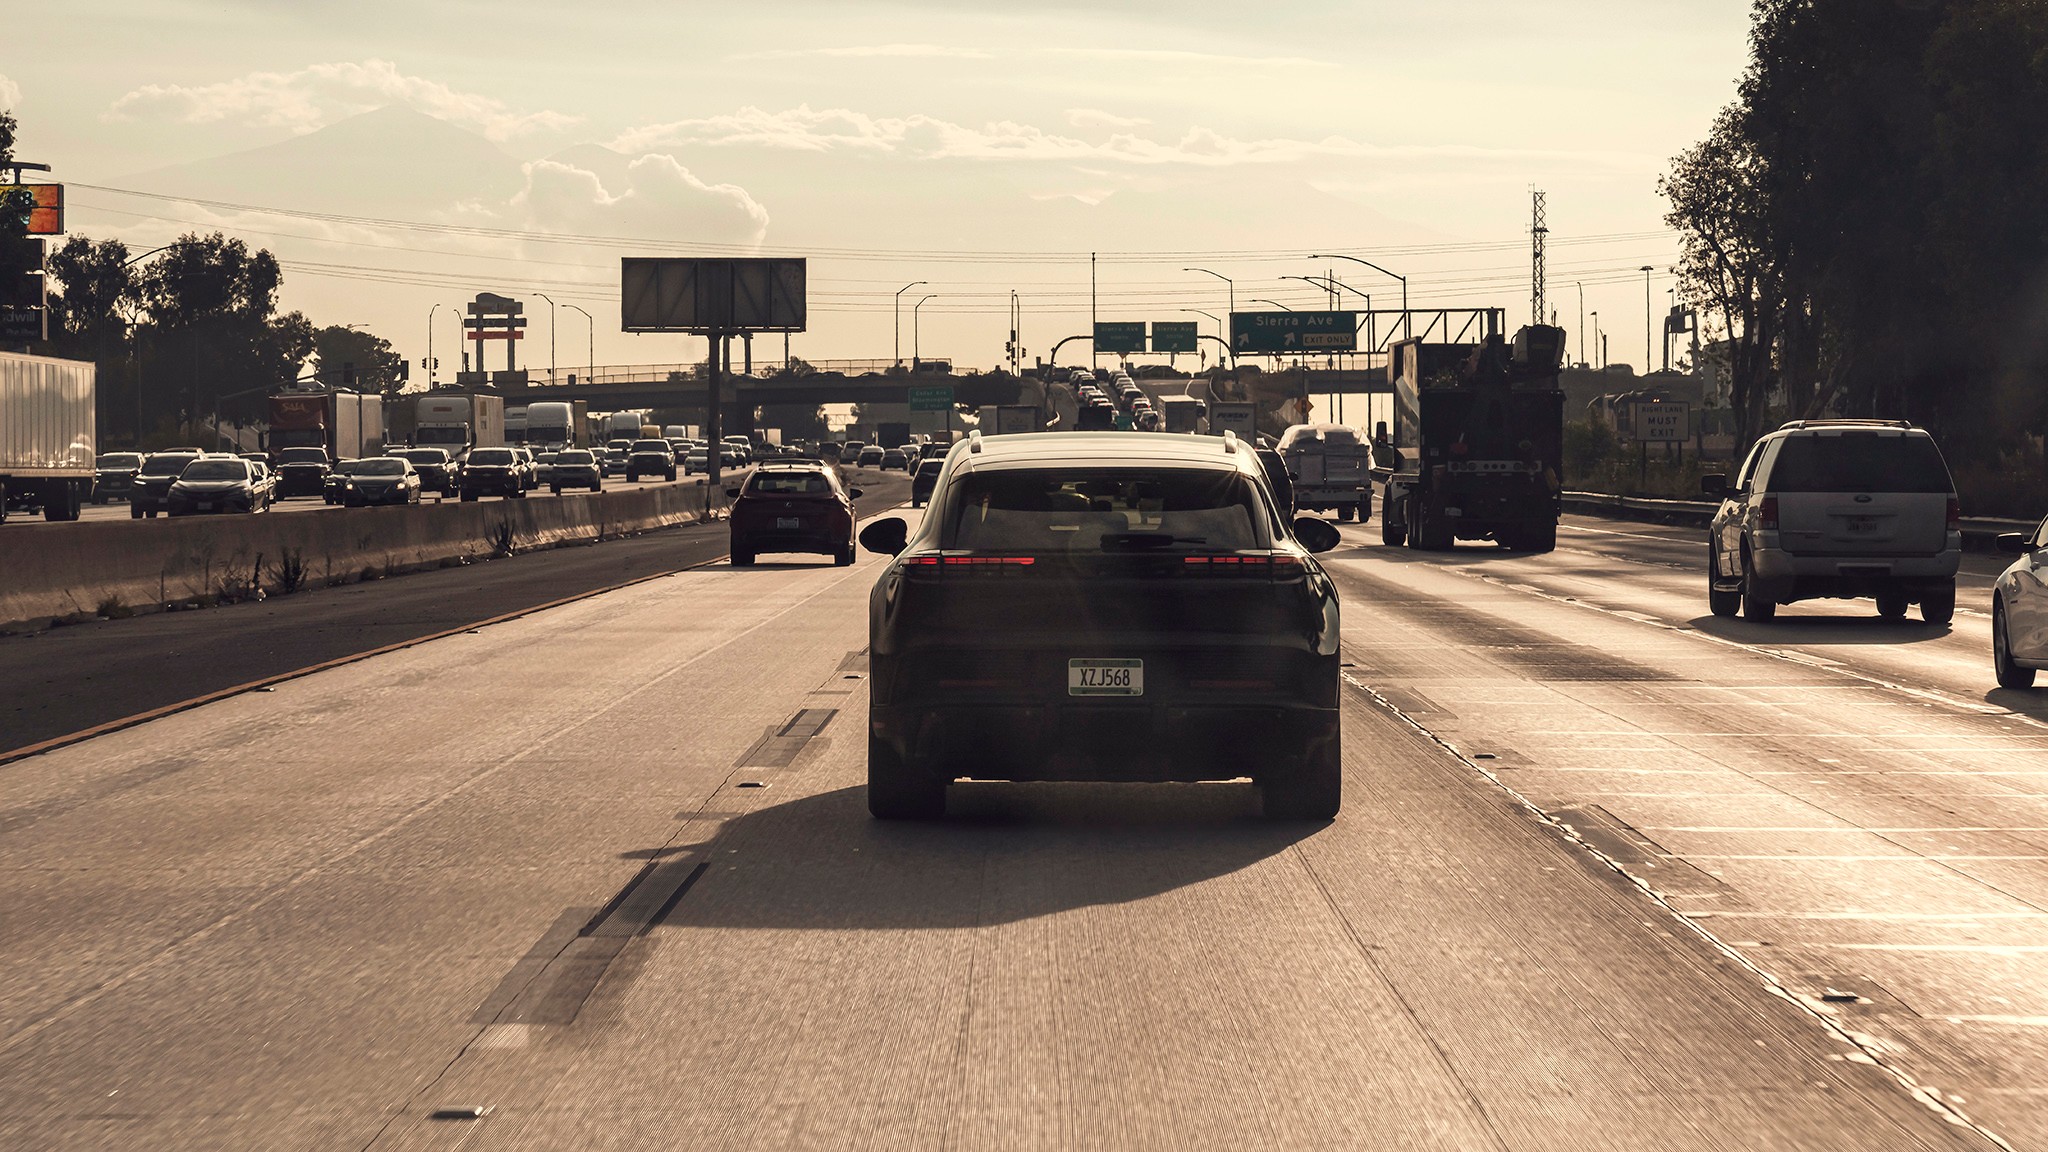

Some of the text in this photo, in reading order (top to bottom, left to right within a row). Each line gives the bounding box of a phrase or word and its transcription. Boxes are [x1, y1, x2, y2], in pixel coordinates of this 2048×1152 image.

[1256, 315, 1333, 326] Sierra Ave
[1305, 336, 1323, 344] EXIT
[282, 402, 305, 411] SAIA
[1648, 416, 1677, 425] MUST
[1650, 428, 1674, 437] EXIT
[1080, 668, 1130, 686] XZJ568
